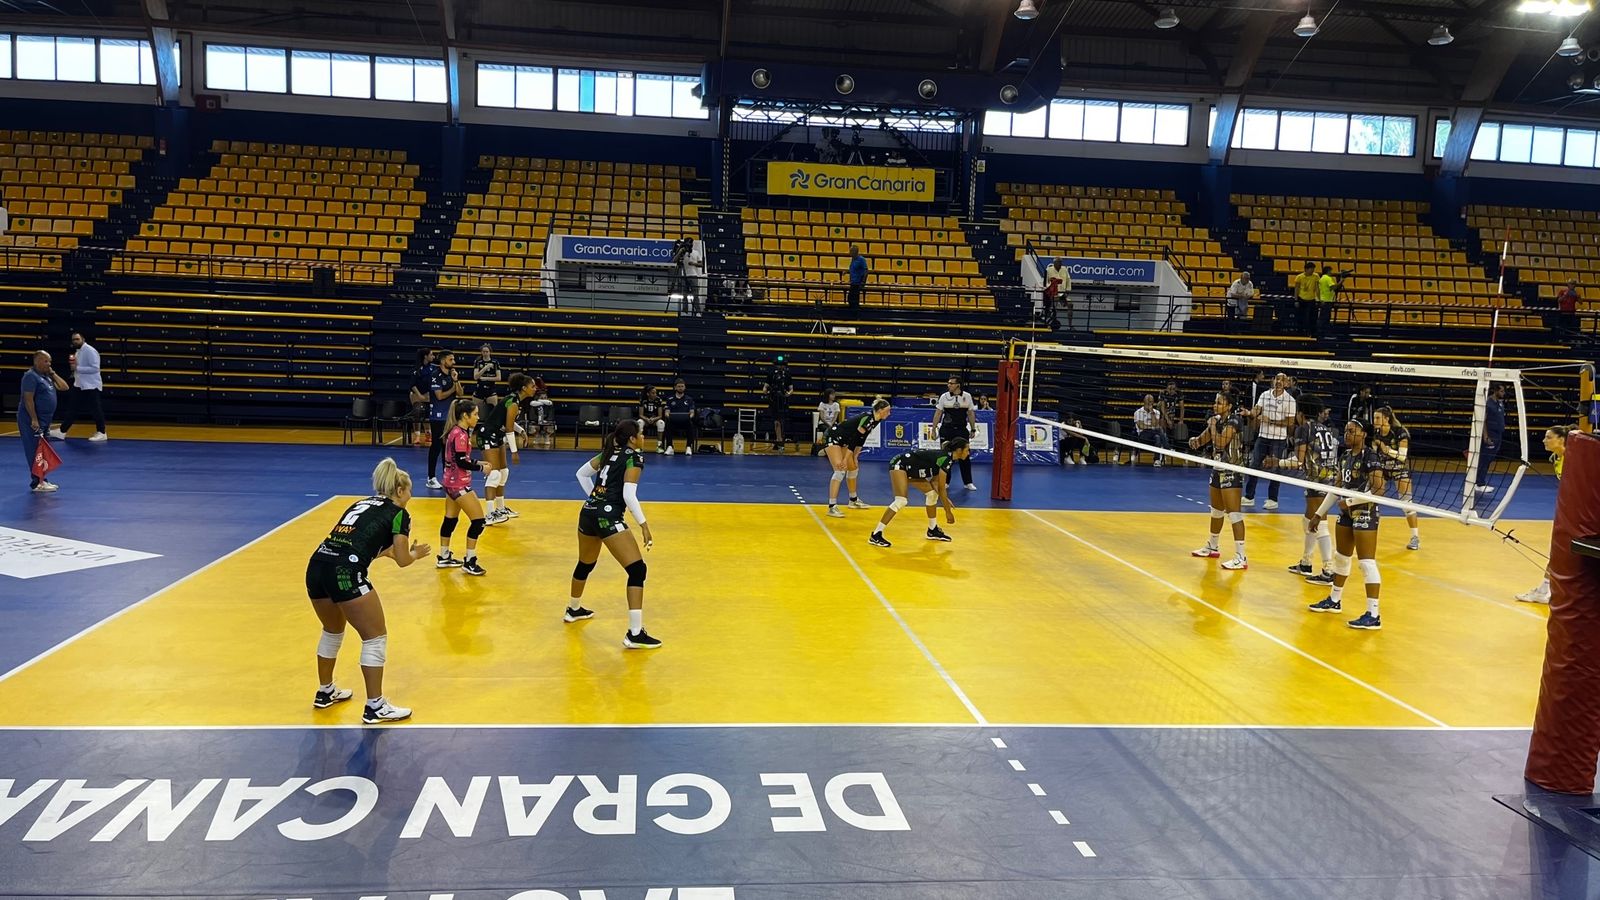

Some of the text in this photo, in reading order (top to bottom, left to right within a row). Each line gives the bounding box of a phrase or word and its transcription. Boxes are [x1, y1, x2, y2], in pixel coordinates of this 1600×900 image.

[814, 173, 926, 193] GranCanaria
[1389, 365, 1416, 373] rfevb.com
[1315, 431, 1333, 450] 10
[599, 464, 611, 486] 4
[1341, 468, 1352, 483] 18
[341, 504, 371, 526] 2
[400, 773, 732, 839] GRAN
[760, 772, 911, 832] DE
